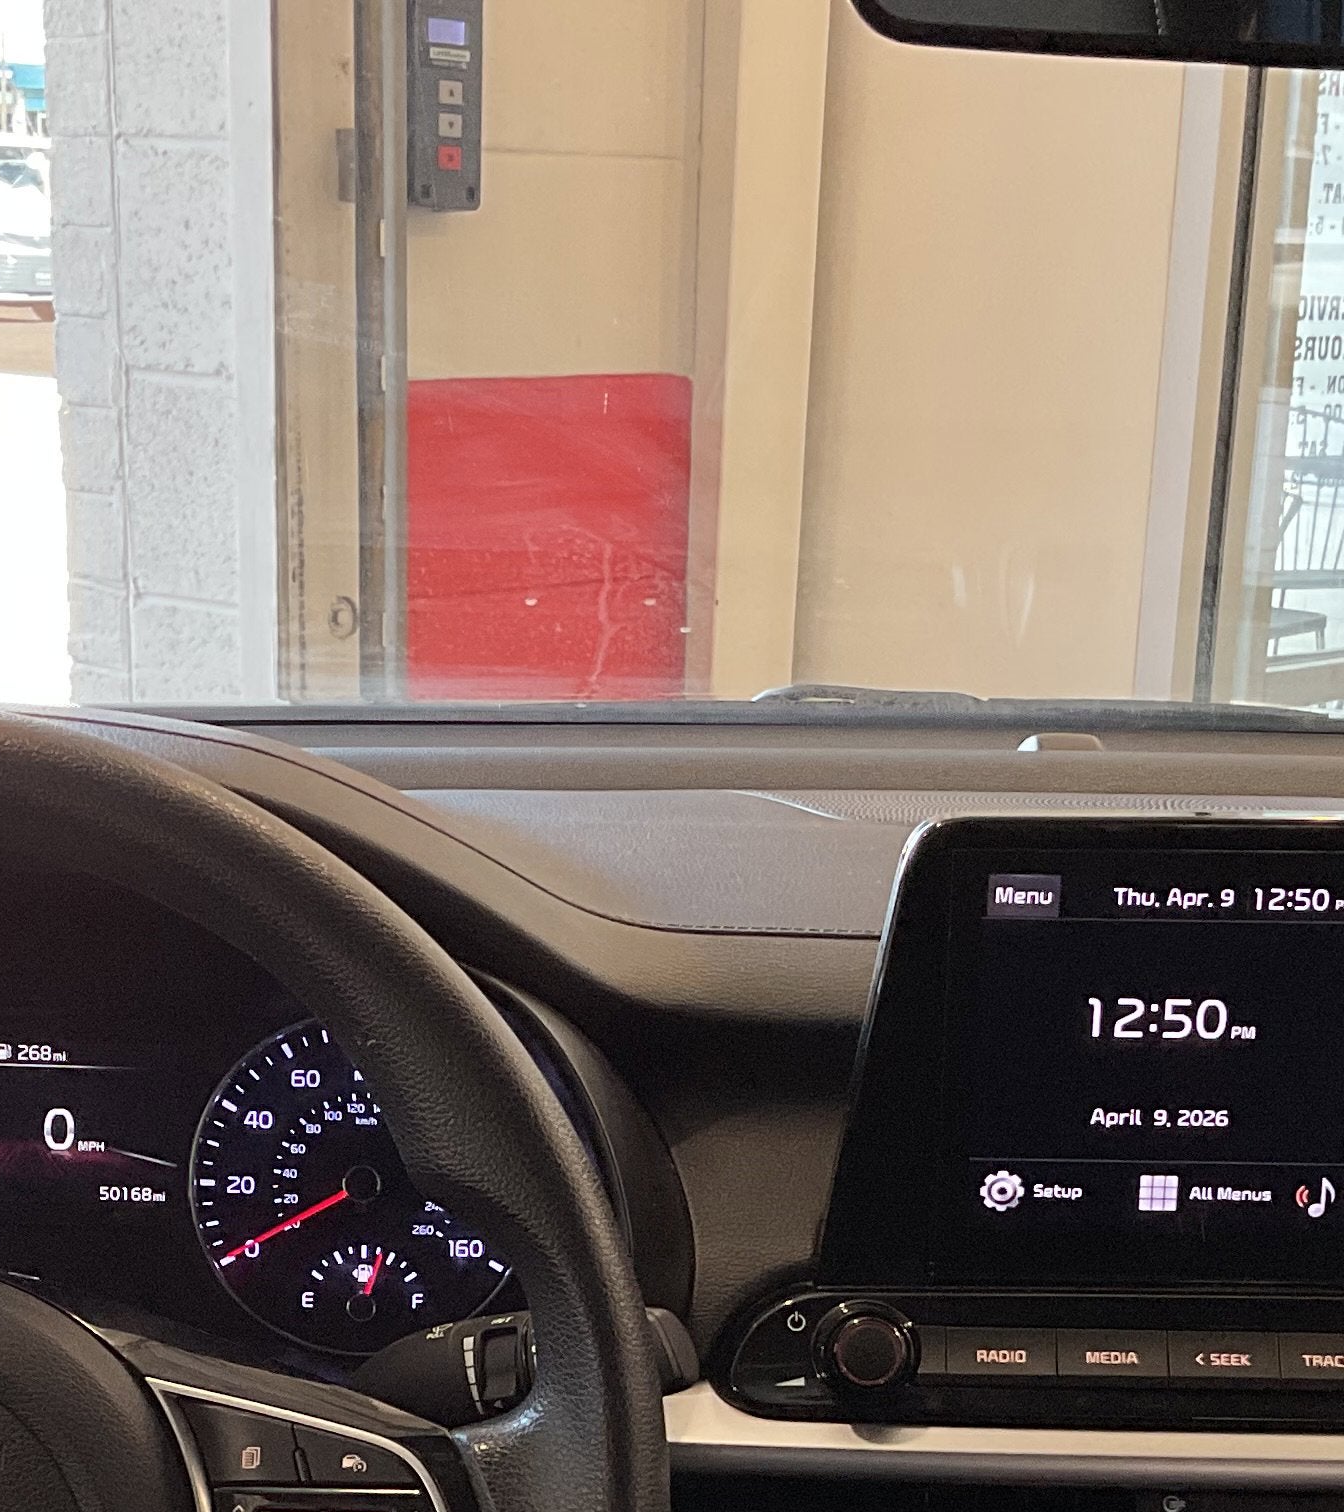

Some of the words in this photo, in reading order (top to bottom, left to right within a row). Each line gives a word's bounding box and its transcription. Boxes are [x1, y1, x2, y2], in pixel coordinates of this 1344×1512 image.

[994, 886, 1053, 905] Menu
[1166, 887, 1214, 910] Apr.
[1220, 888, 1235, 907] 9
[1254, 888, 1330, 912] 12:50
[1088, 997, 1228, 1040] 12:50
[1230, 1026, 1257, 1040] PM
[290, 1069, 321, 1088] 60
[323, 1110, 343, 1121] 100
[346, 1102, 366, 1114] 120
[243, 1110, 274, 1130] 40
[1089, 1107, 1143, 1128] April
[1177, 1109, 1229, 1127] 2026
[43, 1107, 75, 1151] 0
[77, 1140, 106, 1152] MPH
[305, 1123, 322, 1134] 80
[289, 1143, 306, 1154] 60
[282, 1168, 298, 1179] 40
[226, 1175, 255, 1194] 20
[1032, 1183, 1083, 1200] Setup
[283, 1193, 299, 1204] 20
[1188, 1186, 1213, 1201] All
[1216, 1186, 1273, 1202] Menus
[411, 1225, 435, 1236] 260
[244, 1239, 260, 1258] 0
[447, 1239, 485, 1258] 160
[302, 1291, 314, 1308] E
[411, 1292, 424, 1308] F
[976, 1349, 1027, 1364] RADIO
[1085, 1350, 1139, 1365] MEDIA
[1209, 1352, 1252, 1367] SEEK
